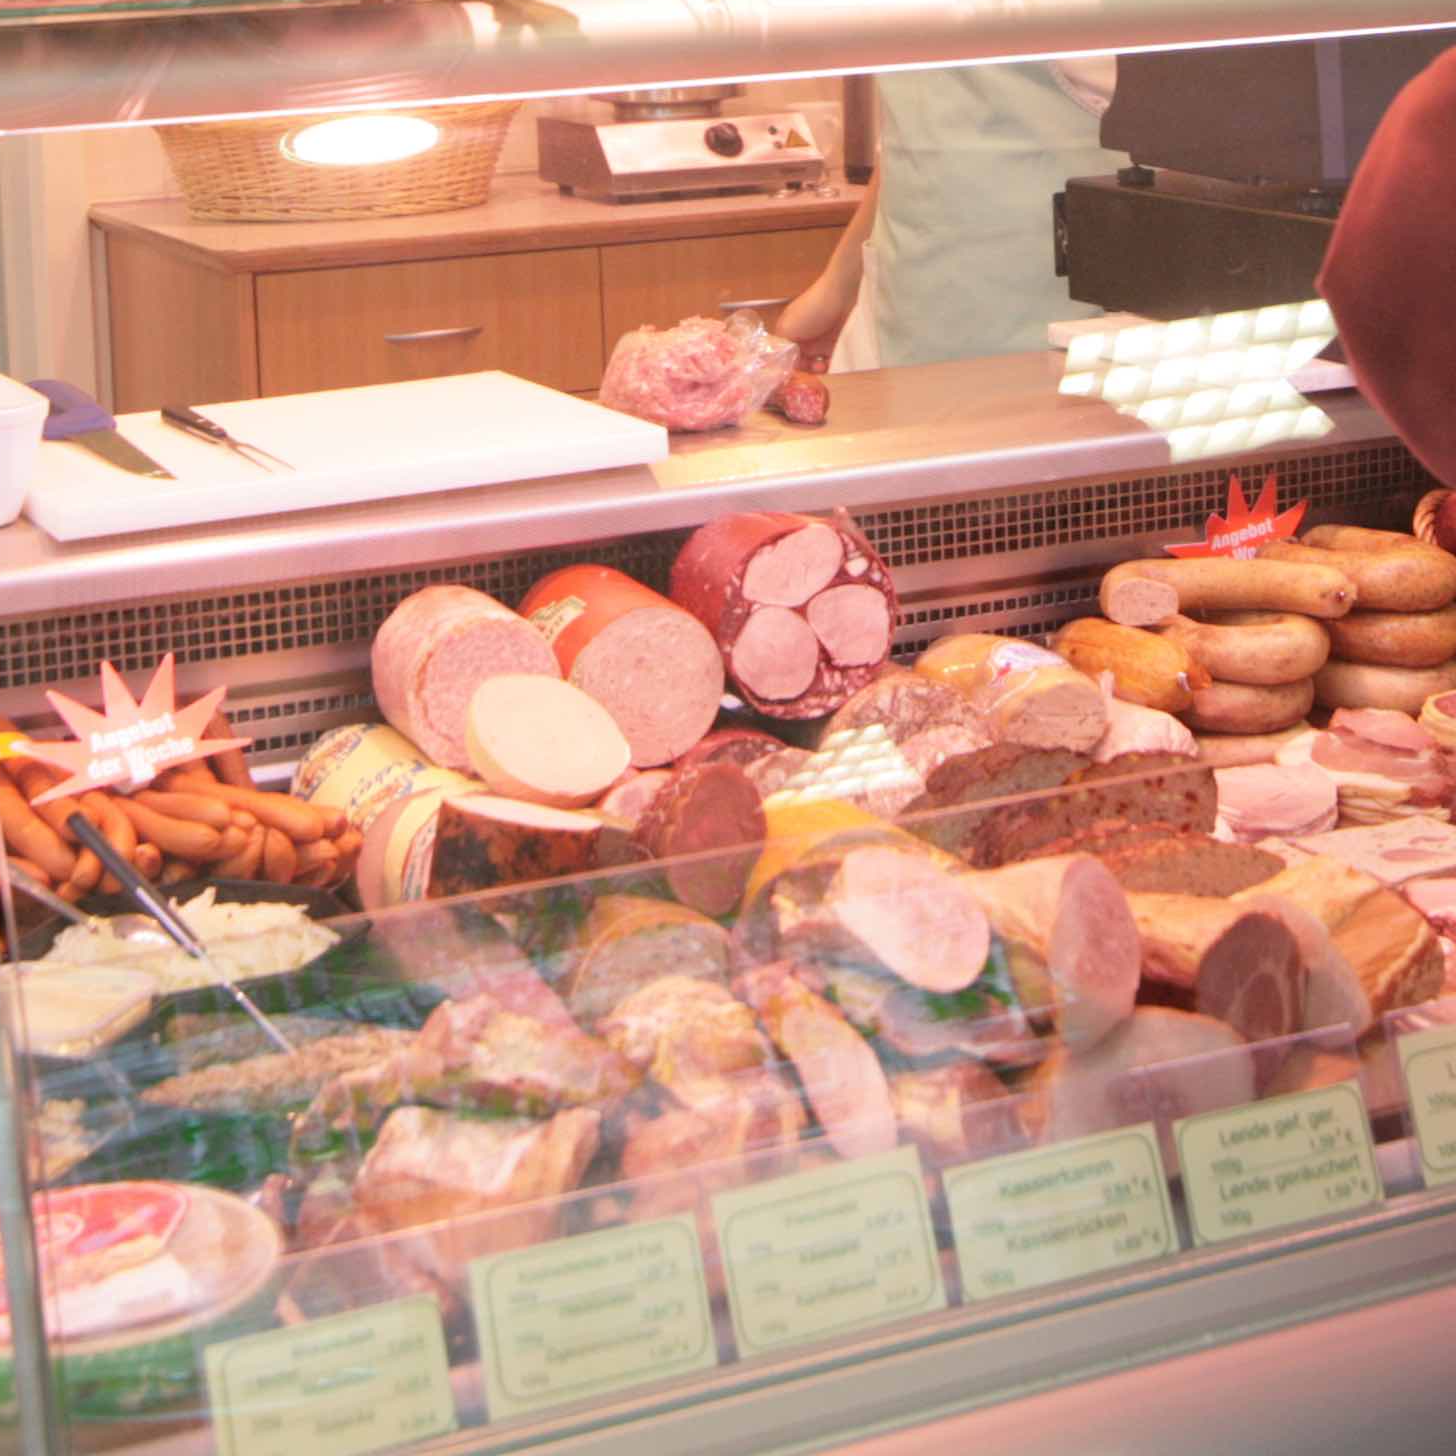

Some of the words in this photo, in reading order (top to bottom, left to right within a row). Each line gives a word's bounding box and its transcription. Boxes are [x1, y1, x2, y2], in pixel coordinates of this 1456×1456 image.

[1210, 517, 1275, 552] Angebot
[89, 711, 176, 753] Angebot
[1217, 1122, 1271, 1149] Lende
[1217, 1176, 1272, 1203] Lende
